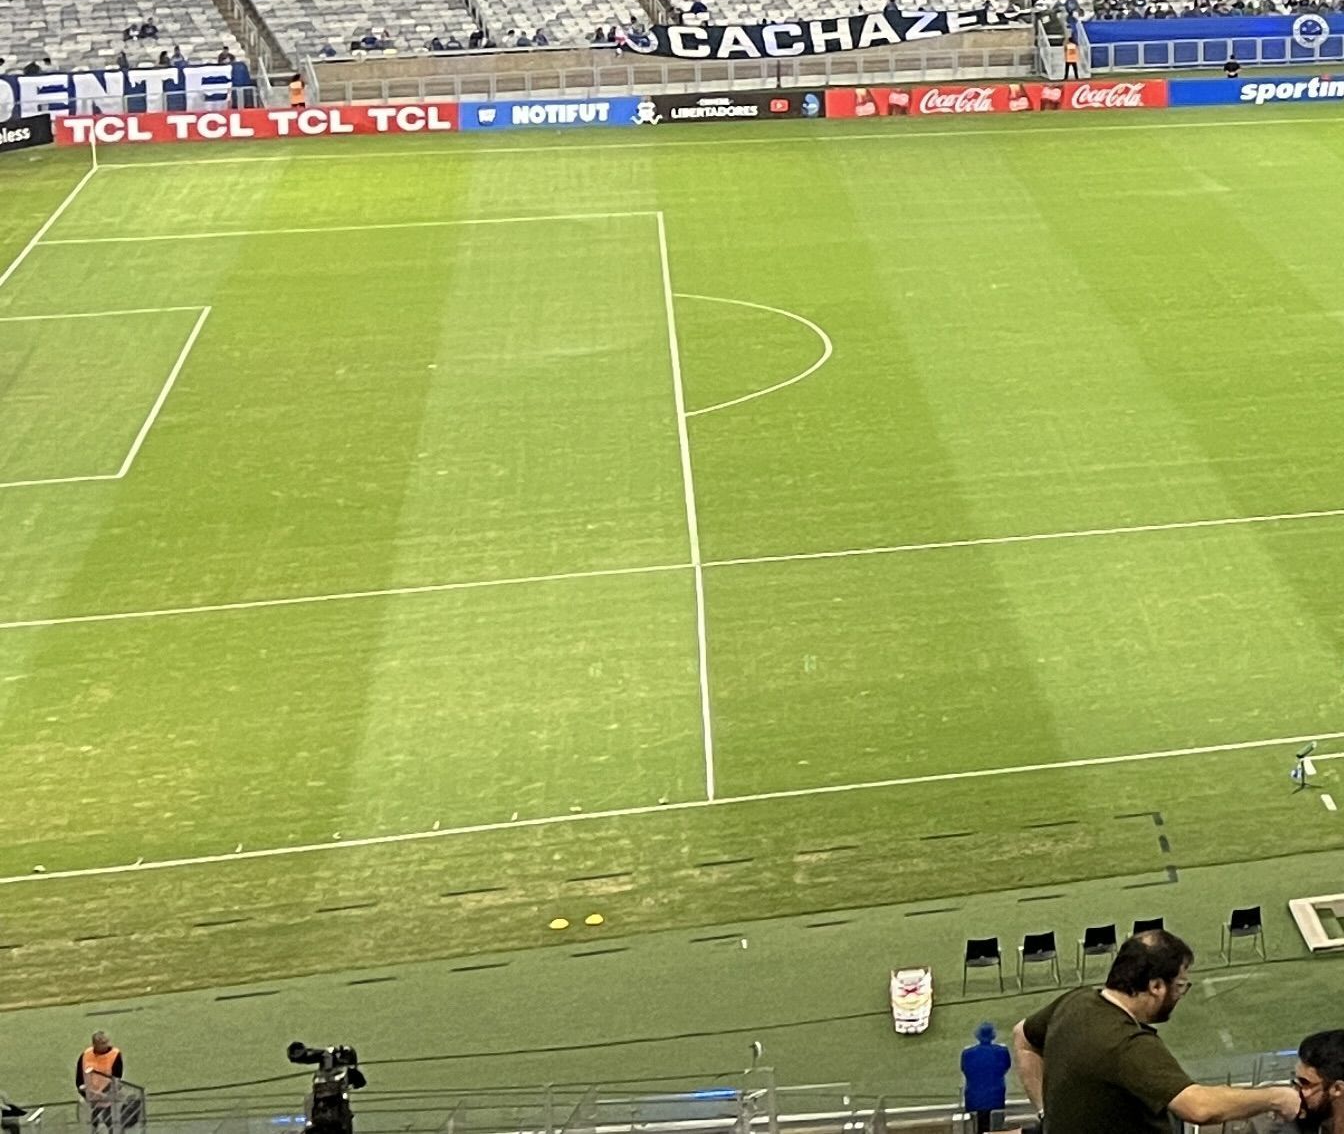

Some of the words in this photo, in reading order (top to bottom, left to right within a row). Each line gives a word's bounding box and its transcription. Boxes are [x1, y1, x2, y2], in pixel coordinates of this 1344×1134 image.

[511, 102, 610, 125] NOTIFUT
[671, 105, 758, 118] LIBERTADORES
[63, 116, 153, 143] TCL
[167, 112, 254, 140] TCL
[268, 109, 354, 135] TCL
[367, 106, 452, 132] TCL
